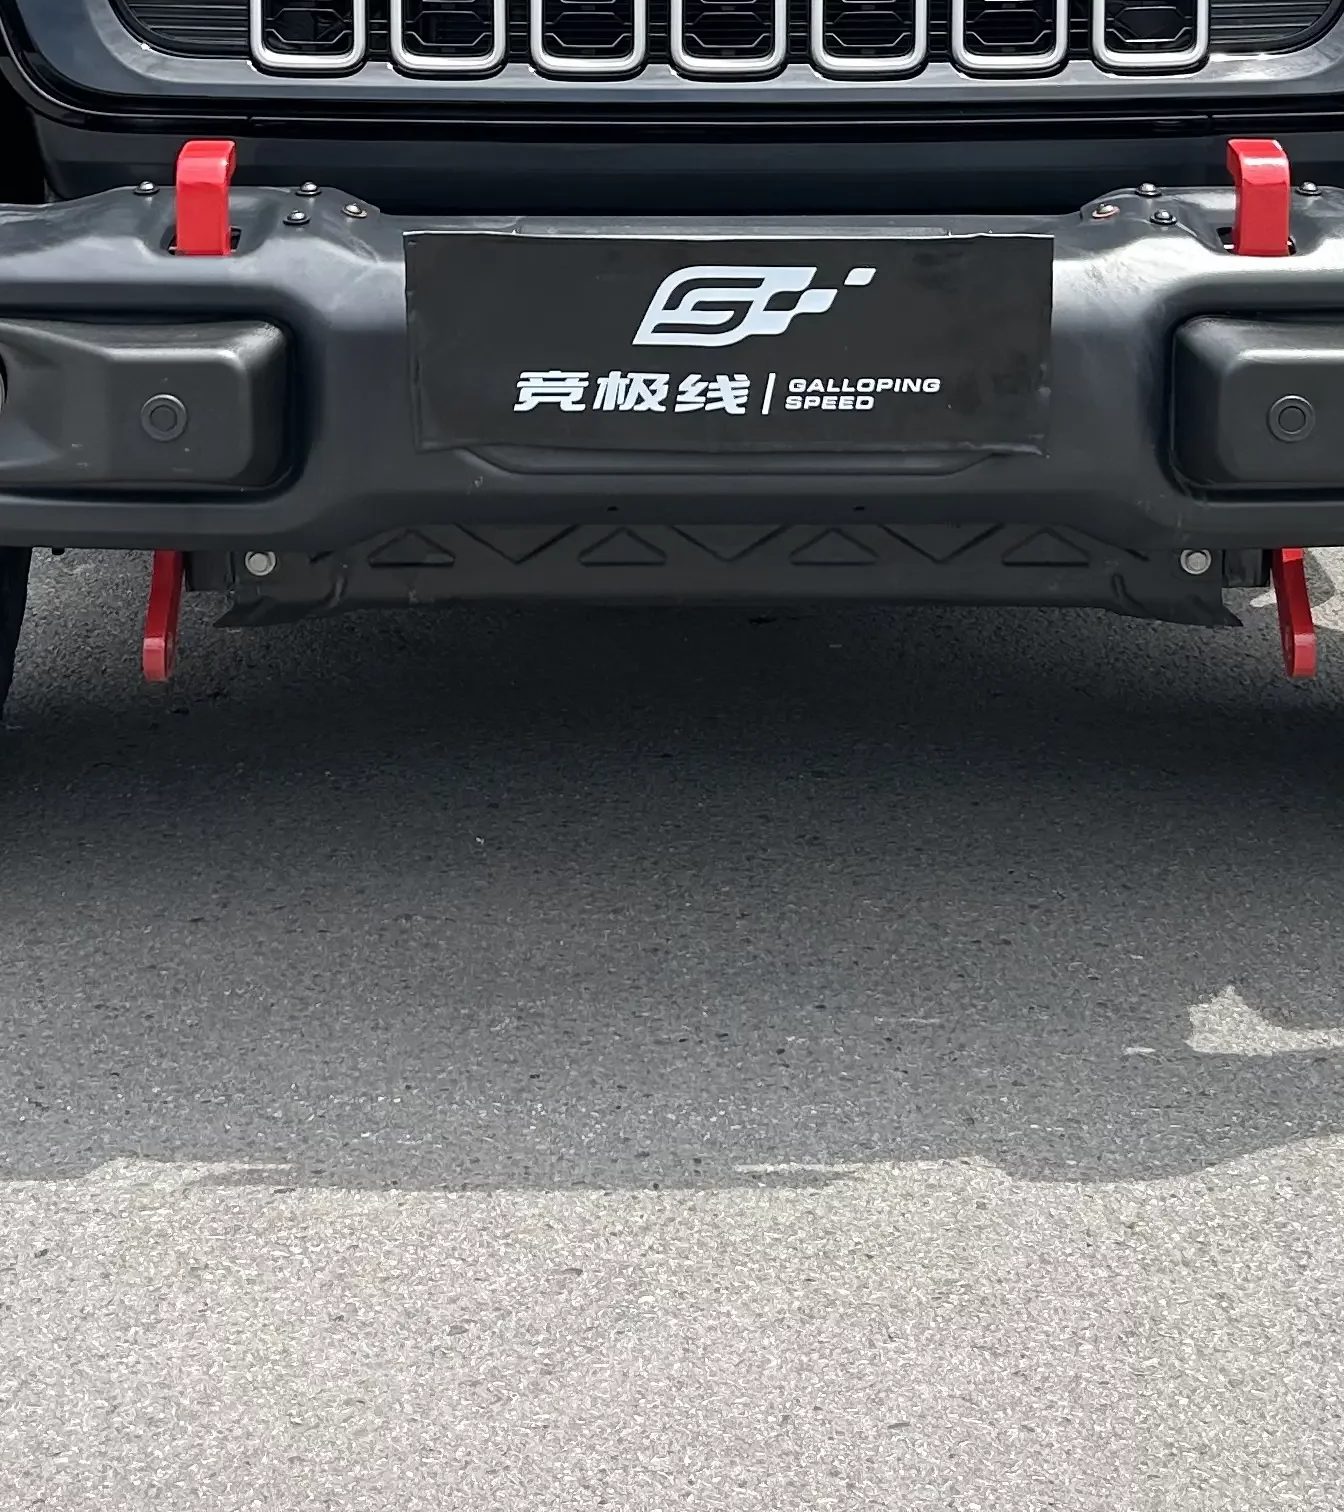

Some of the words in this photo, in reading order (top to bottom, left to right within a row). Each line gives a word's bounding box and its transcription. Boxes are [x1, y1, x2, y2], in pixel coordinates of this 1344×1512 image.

[513, 370, 751, 415] 竞极线
[786, 377, 942, 394] GALLOPING
[784, 395, 875, 411] SPEED
